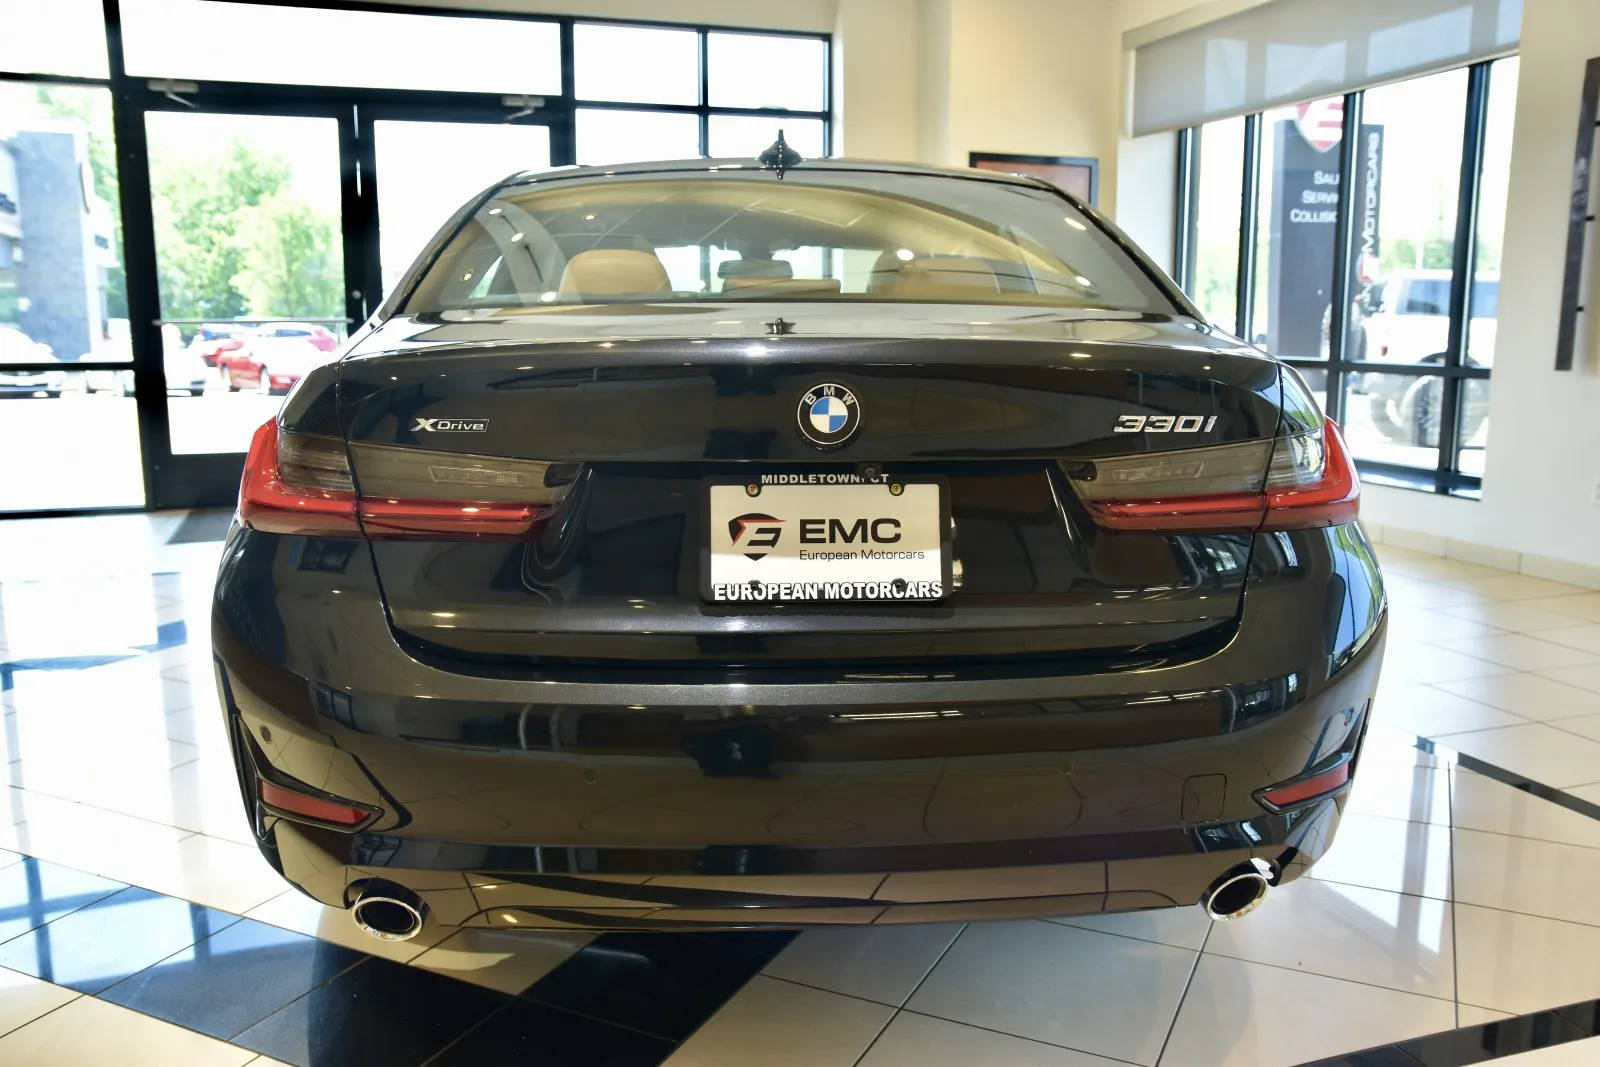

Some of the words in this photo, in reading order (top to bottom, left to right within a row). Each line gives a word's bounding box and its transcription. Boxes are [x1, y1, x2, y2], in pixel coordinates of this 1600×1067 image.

[1313, 170, 1340, 185] SAL
[1302, 189, 1339, 204] SERVI
[804, 386, 855, 406] BMW
[799, 518, 902, 544] EMC
[799, 549, 858, 562] European
[861, 549, 925, 560] Motorcars
[714, 582, 818, 600] EUROPEAN
[826, 580, 943, 599] MOTORCARS
